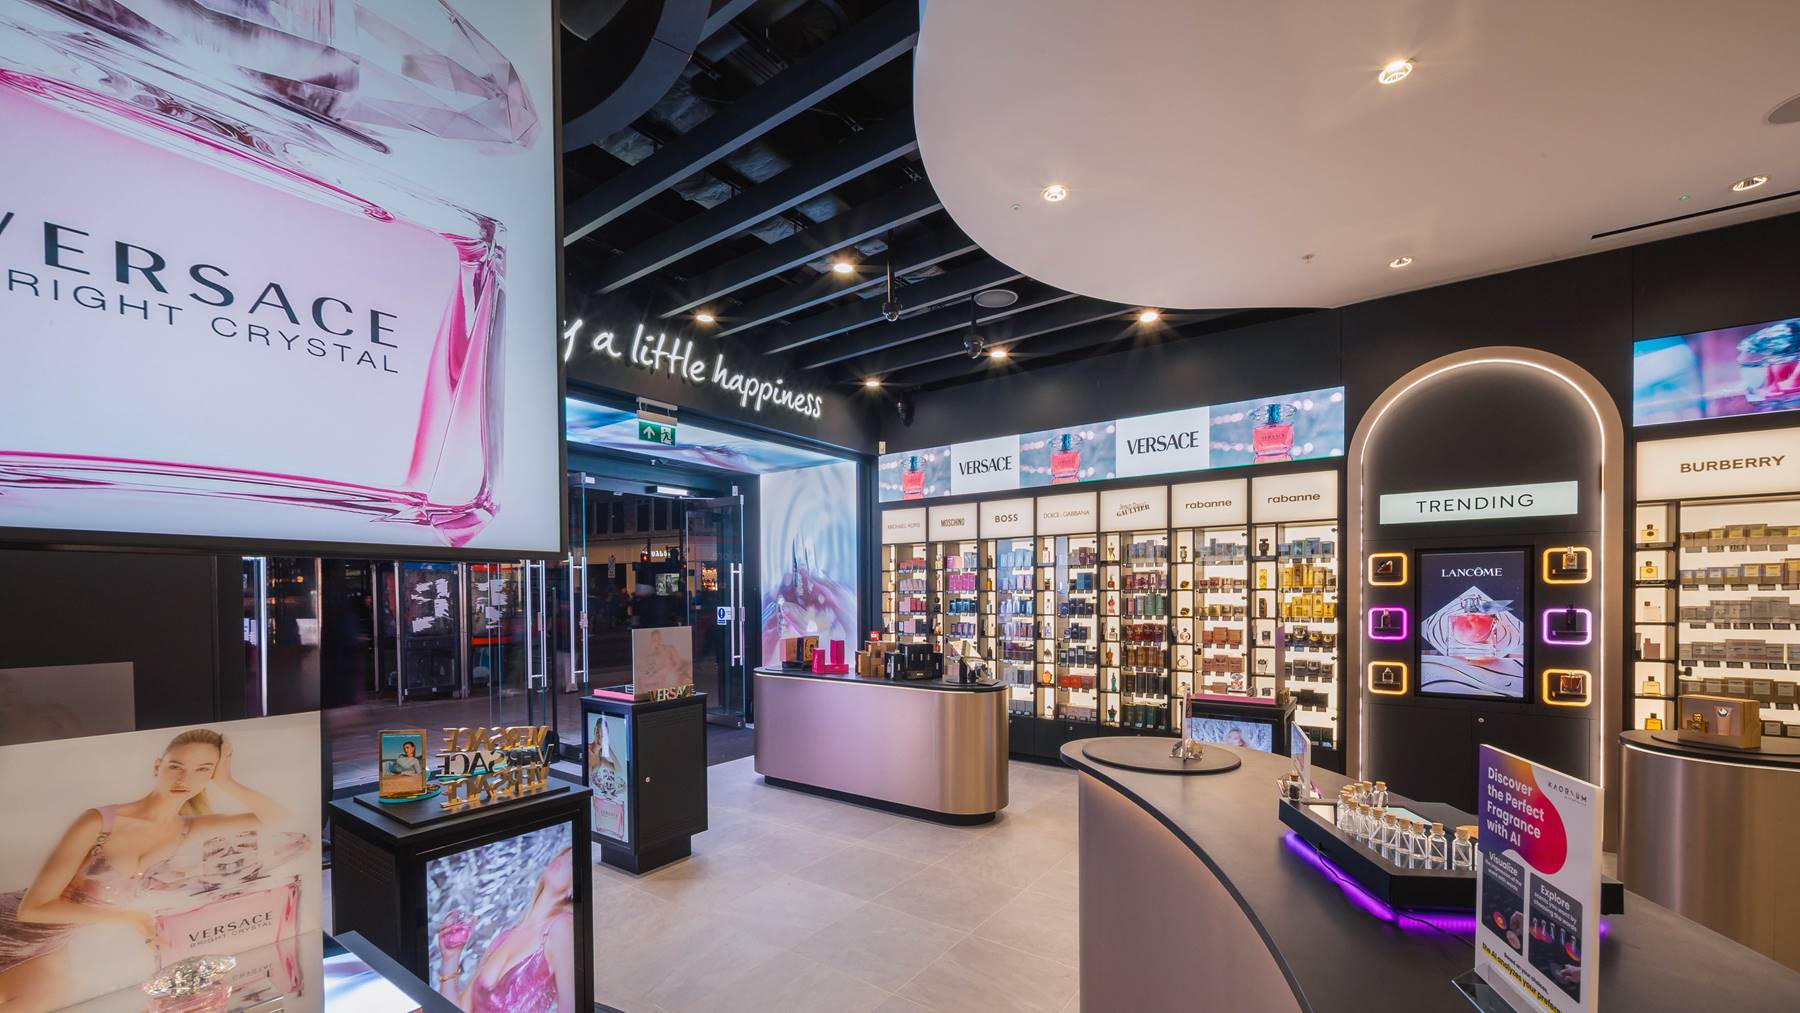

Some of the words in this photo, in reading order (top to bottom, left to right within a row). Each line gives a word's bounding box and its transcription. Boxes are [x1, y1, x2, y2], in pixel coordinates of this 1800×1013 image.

[0, 211, 398, 348] ERSACE
[211, 316, 399, 374] CRYSTAL
[593, 332, 621, 358] a
[631, 323, 706, 382] little
[712, 353, 823, 418] happiness
[1127, 430, 1199, 455] VERSACE
[959, 456, 1012, 476] VERSACE
[1680, 455, 1785, 473] BURBERRY
[1185, 499, 1232, 510] rabanne
[1267, 492, 1320, 504] rabanne
[1416, 493, 1535, 514] TRENDING
[994, 513, 1019, 523] BOSS
[1441, 566, 1503, 578] LANCÔME
[1488, 766, 1533, 796] Discover
[1487, 783, 1504, 801] the
[1505, 791, 1545, 822] Perfect
[1486, 818, 1508, 839] with
[1510, 831, 1521, 847] AI
[1487, 800, 1541, 839] Fragrance
[1489, 851, 1518, 877] Visualize
[1541, 884, 1570, 911] Explore
[189, 911, 273, 942] VERSACE
[231, 921, 272, 936] CRYSTAL
